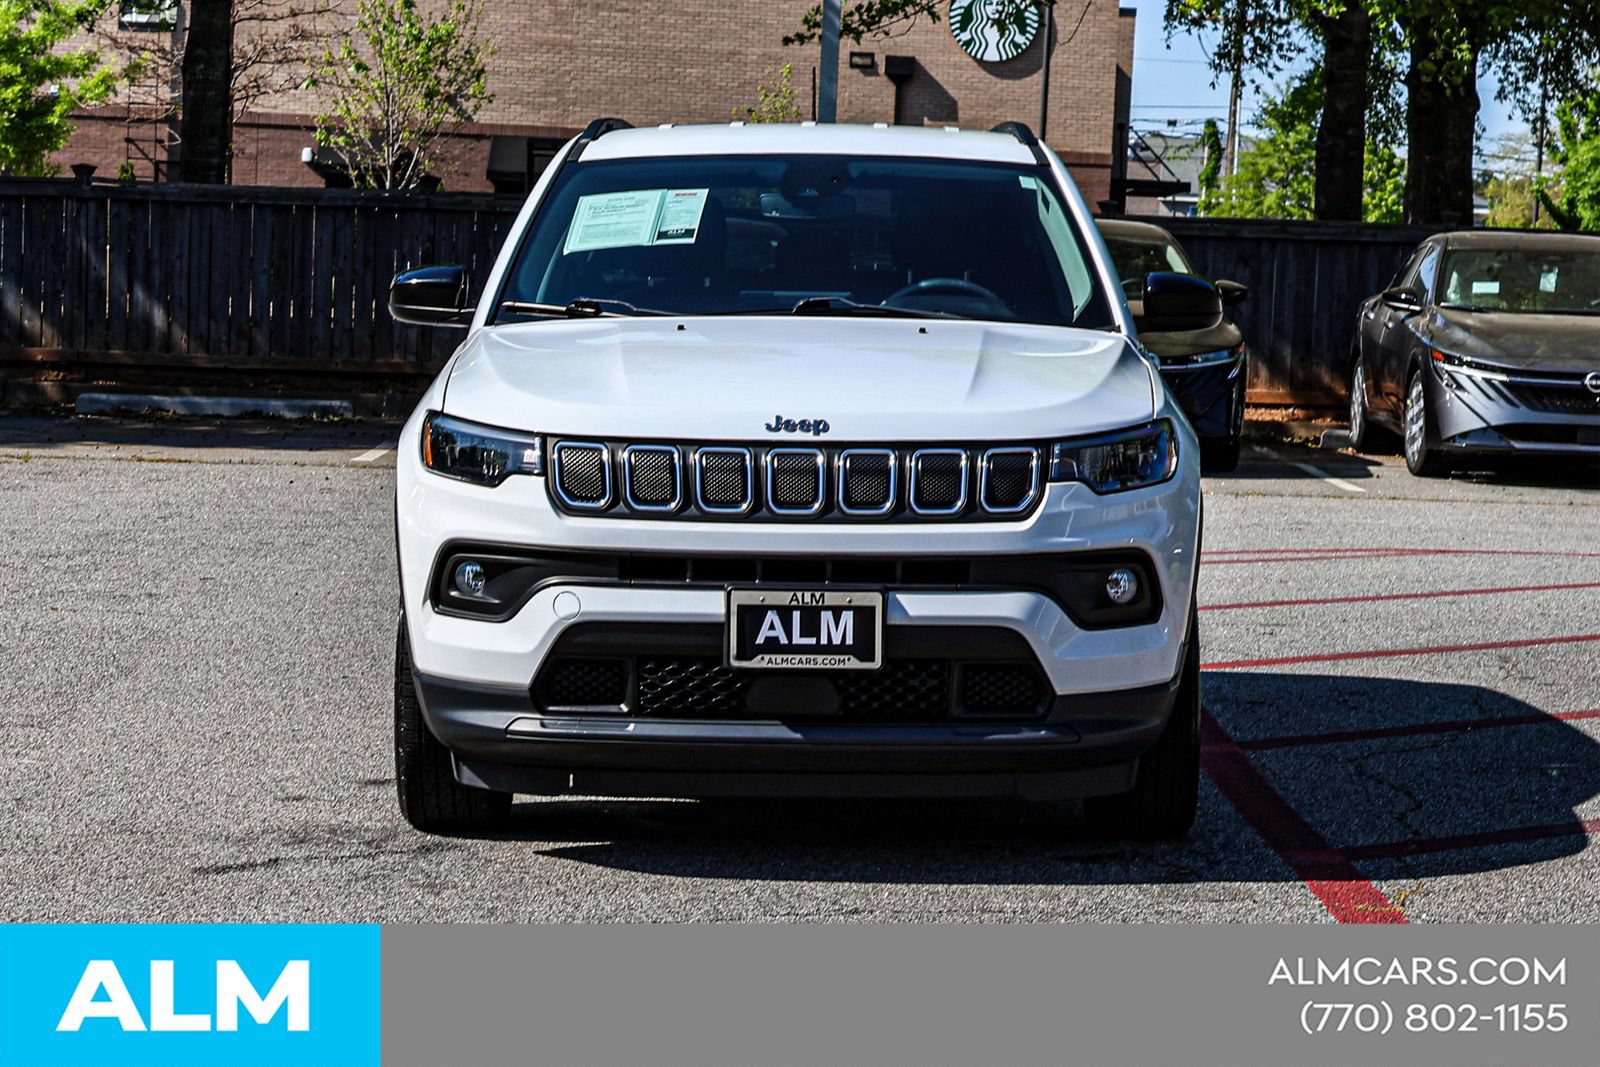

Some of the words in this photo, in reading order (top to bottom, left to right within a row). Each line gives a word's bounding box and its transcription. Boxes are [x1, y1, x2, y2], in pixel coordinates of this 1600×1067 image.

[765, 415, 830, 436] Jeep
[789, 592, 825, 605] ALM
[755, 610, 854, 645] ALM
[767, 657, 846, 667] ALMCARS.COM
